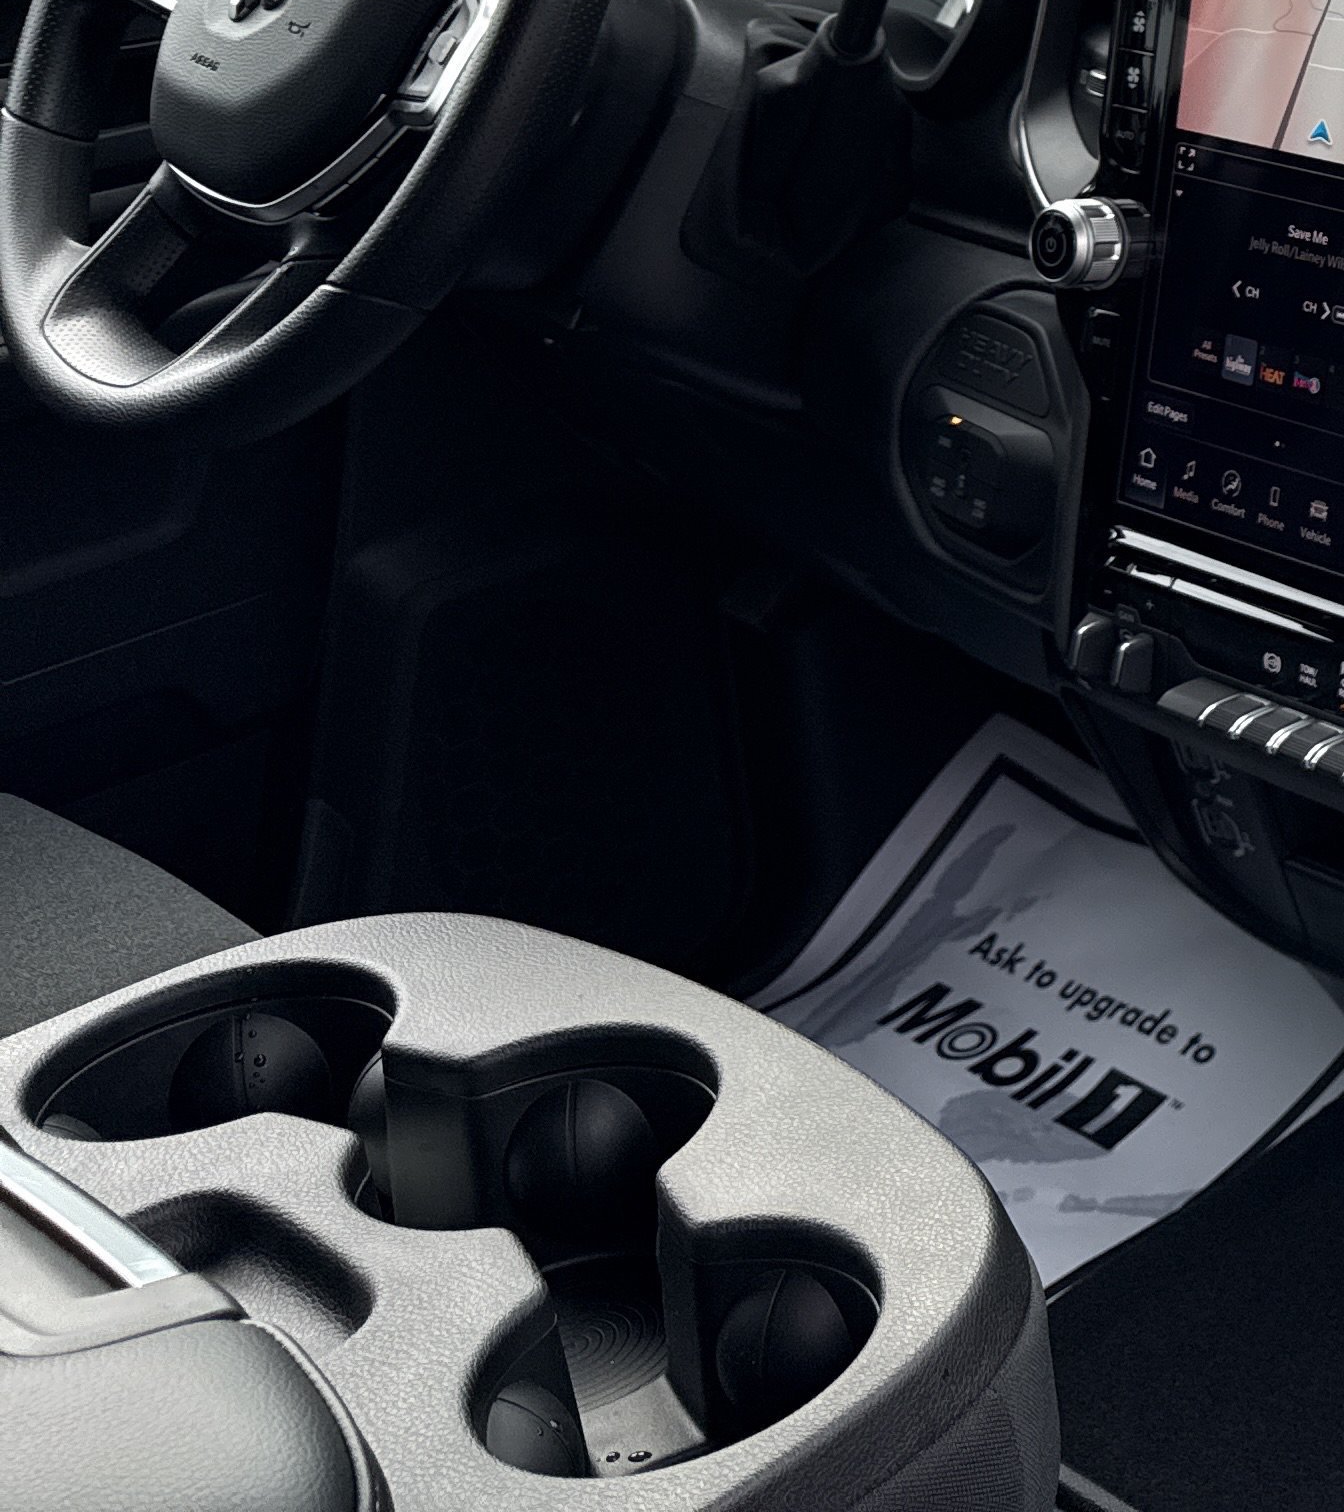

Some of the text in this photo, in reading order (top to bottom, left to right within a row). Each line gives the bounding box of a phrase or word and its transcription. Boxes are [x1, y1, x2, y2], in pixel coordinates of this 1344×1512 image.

[1249, 235, 1271, 255] Jelly
[1287, 224, 1329, 246] Save Me
[1245, 285, 1260, 299] CH
[1302, 300, 1318, 314] CH
[1147, 400, 1189, 424] Edit Pages
[1132, 473, 1158, 491] Home
[1173, 486, 1200, 505] Media
[1210, 498, 1247, 520] Comfort
[1256, 512, 1285, 533] Phone
[1300, 526, 1332, 547] Vehicle
[968, 932, 1217, 1065] Ask to upgrade to
[876, 981, 1097, 1111] Mobil
